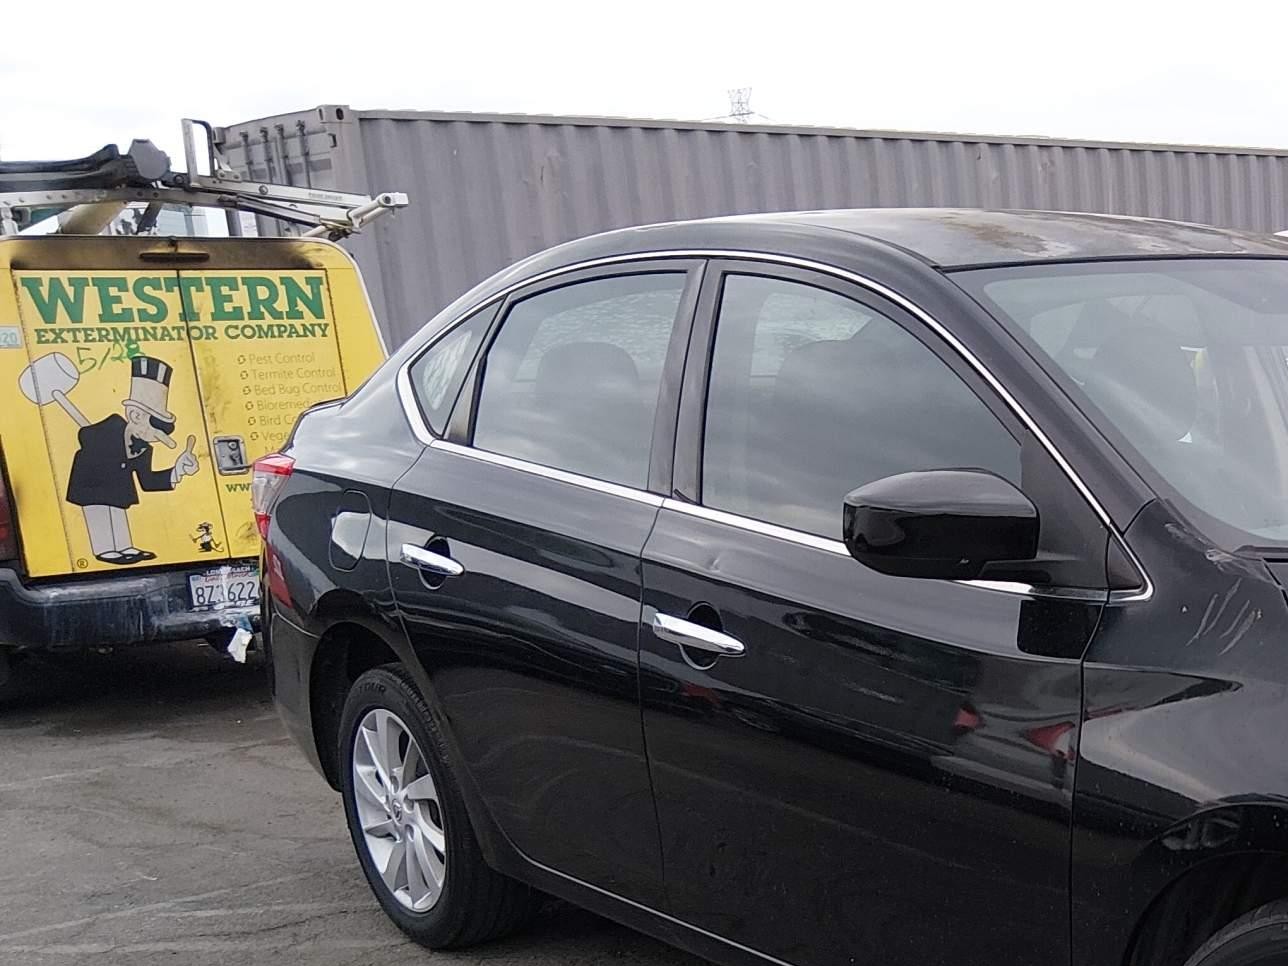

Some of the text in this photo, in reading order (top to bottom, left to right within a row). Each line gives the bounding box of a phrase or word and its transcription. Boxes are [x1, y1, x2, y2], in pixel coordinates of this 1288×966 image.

[21, 276, 326, 324] WESTERN
[35, 323, 330, 345] EXTERMINATOR COMPANY
[249, 352, 315, 365] Pest Control
[252, 367, 336, 380] Termite Control
[254, 383, 342, 397] Bed Bug Control
[260, 415, 281, 427] Bird
